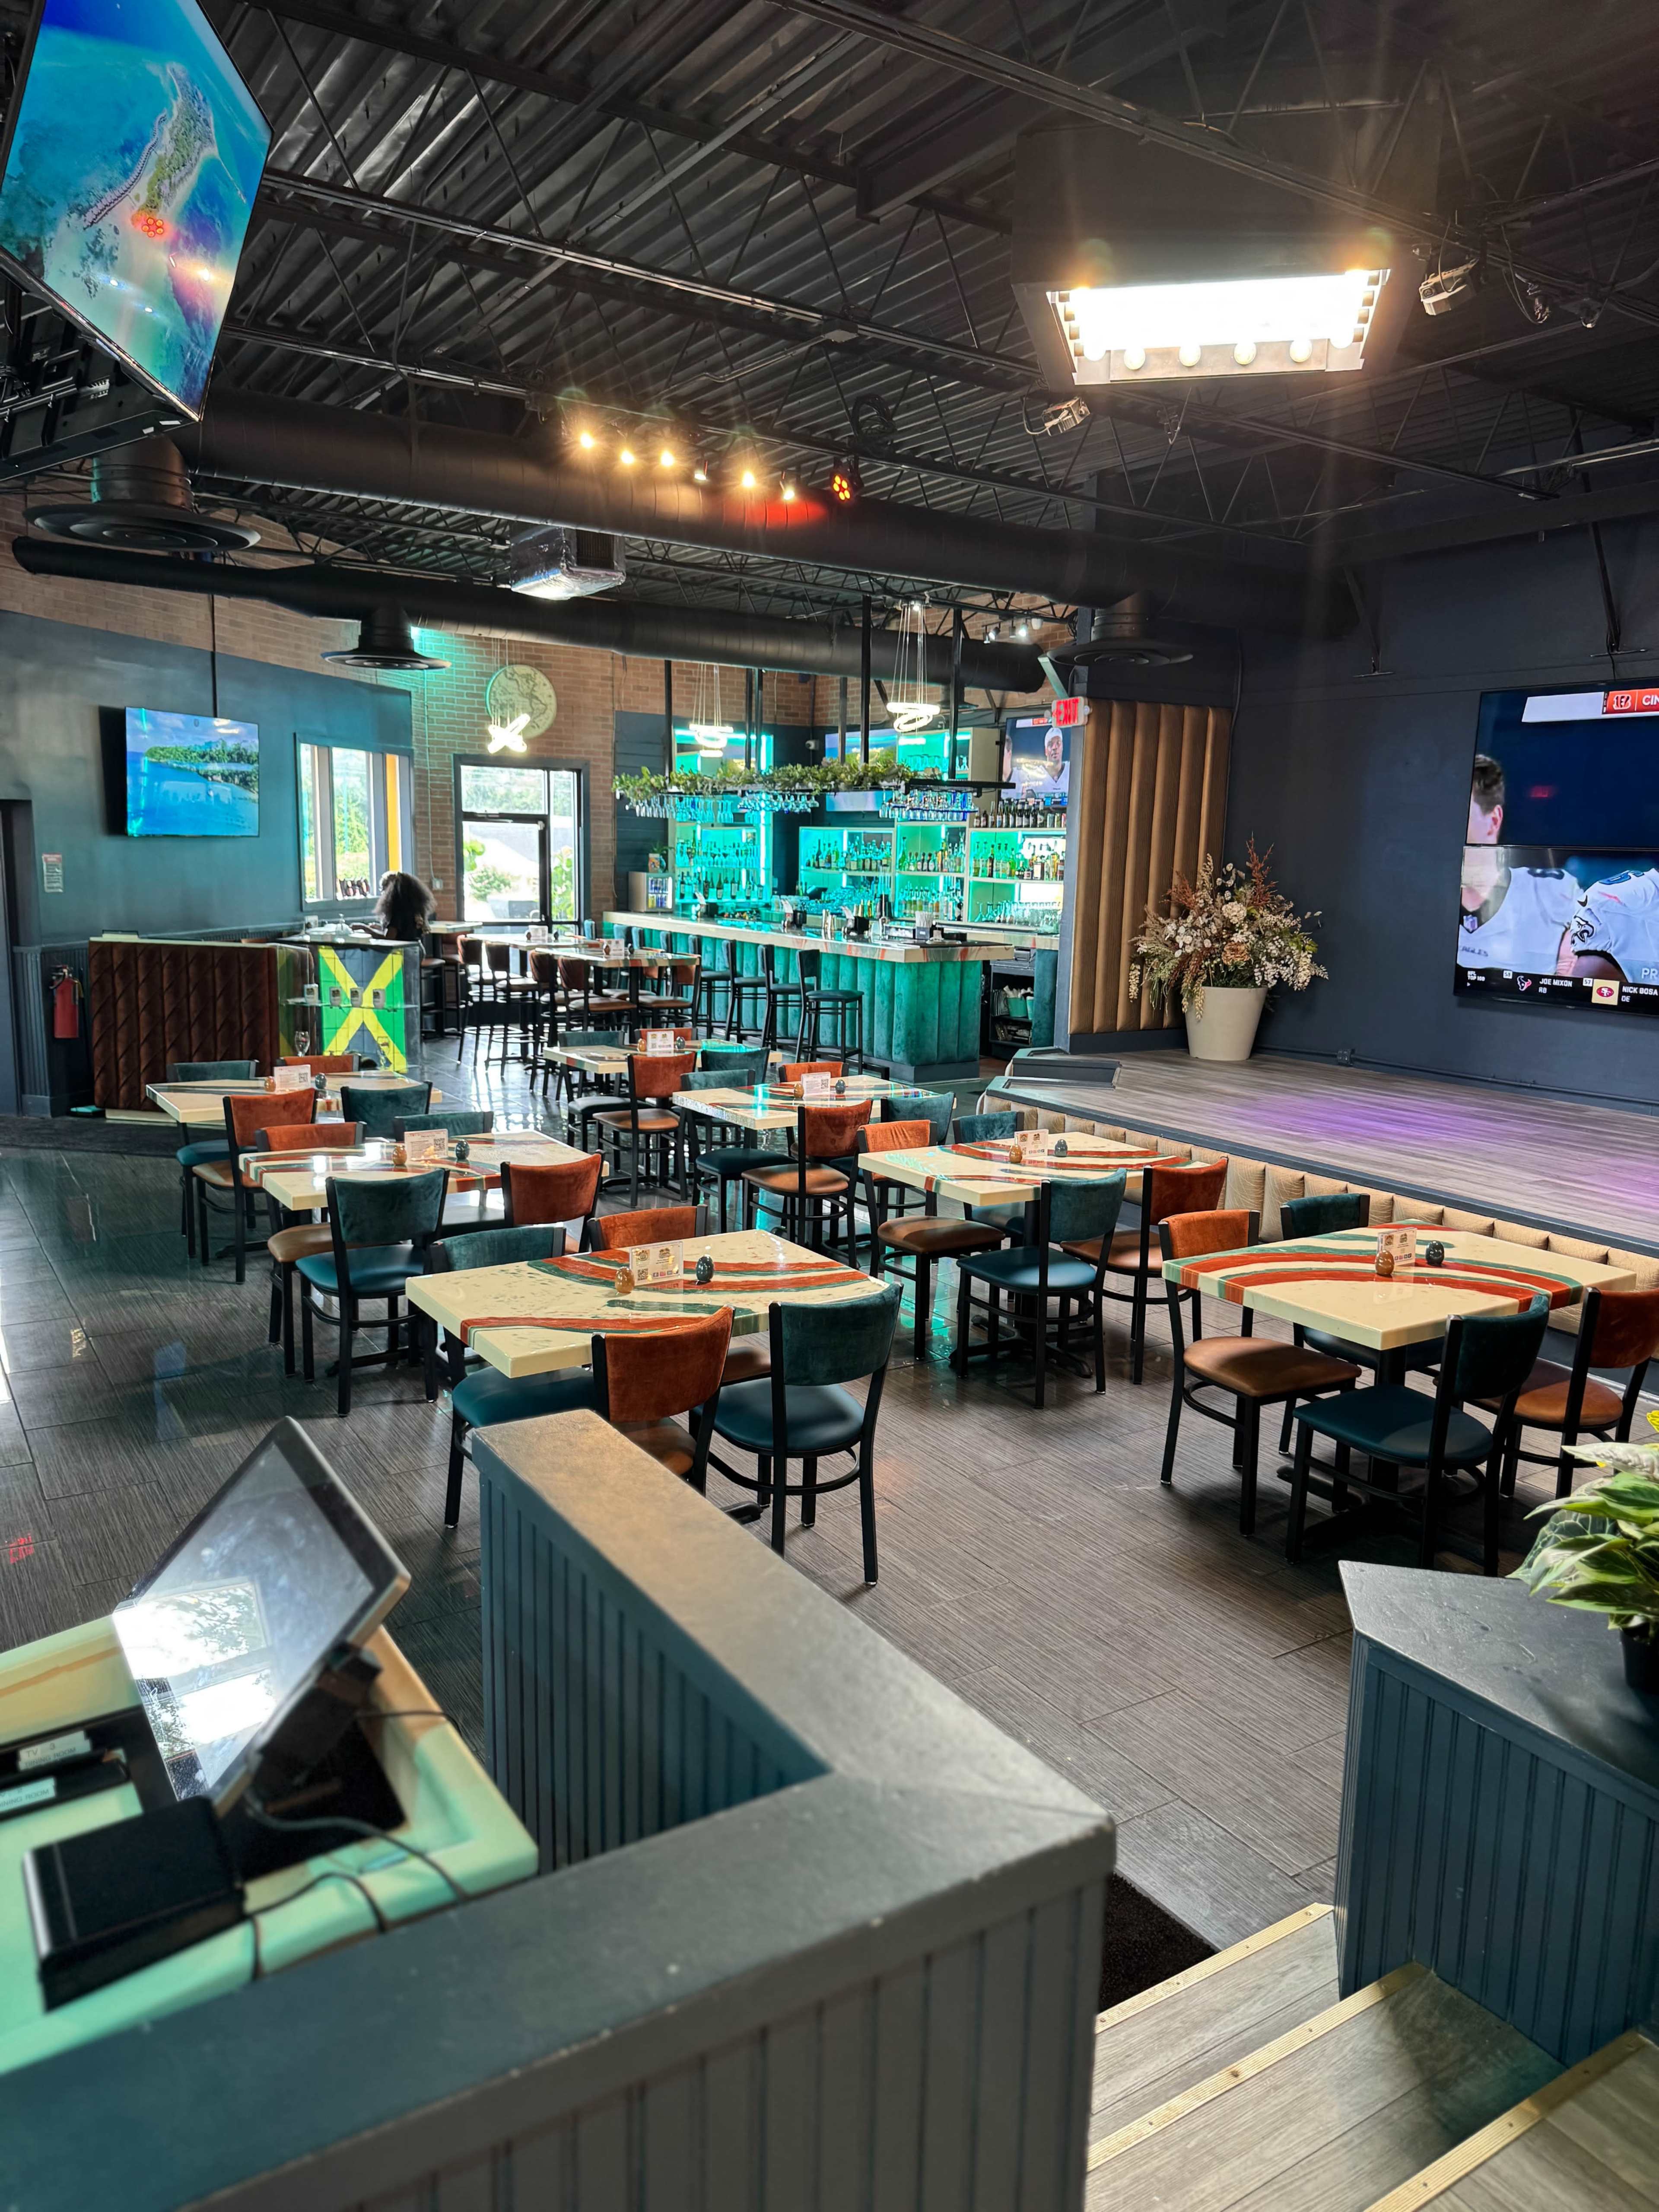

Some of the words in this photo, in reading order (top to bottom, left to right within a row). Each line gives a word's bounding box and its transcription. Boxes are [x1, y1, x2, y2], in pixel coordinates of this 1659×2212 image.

[1056, 697, 1080, 726] EXIT
[1639, 987, 1659, 996] BOSA
[26, 1748, 38, 1757] TV
[54, 1747, 76, 1759] ROOM
[0, 1796, 22, 1807] INING
[25, 1789, 49, 1800] ROOM
